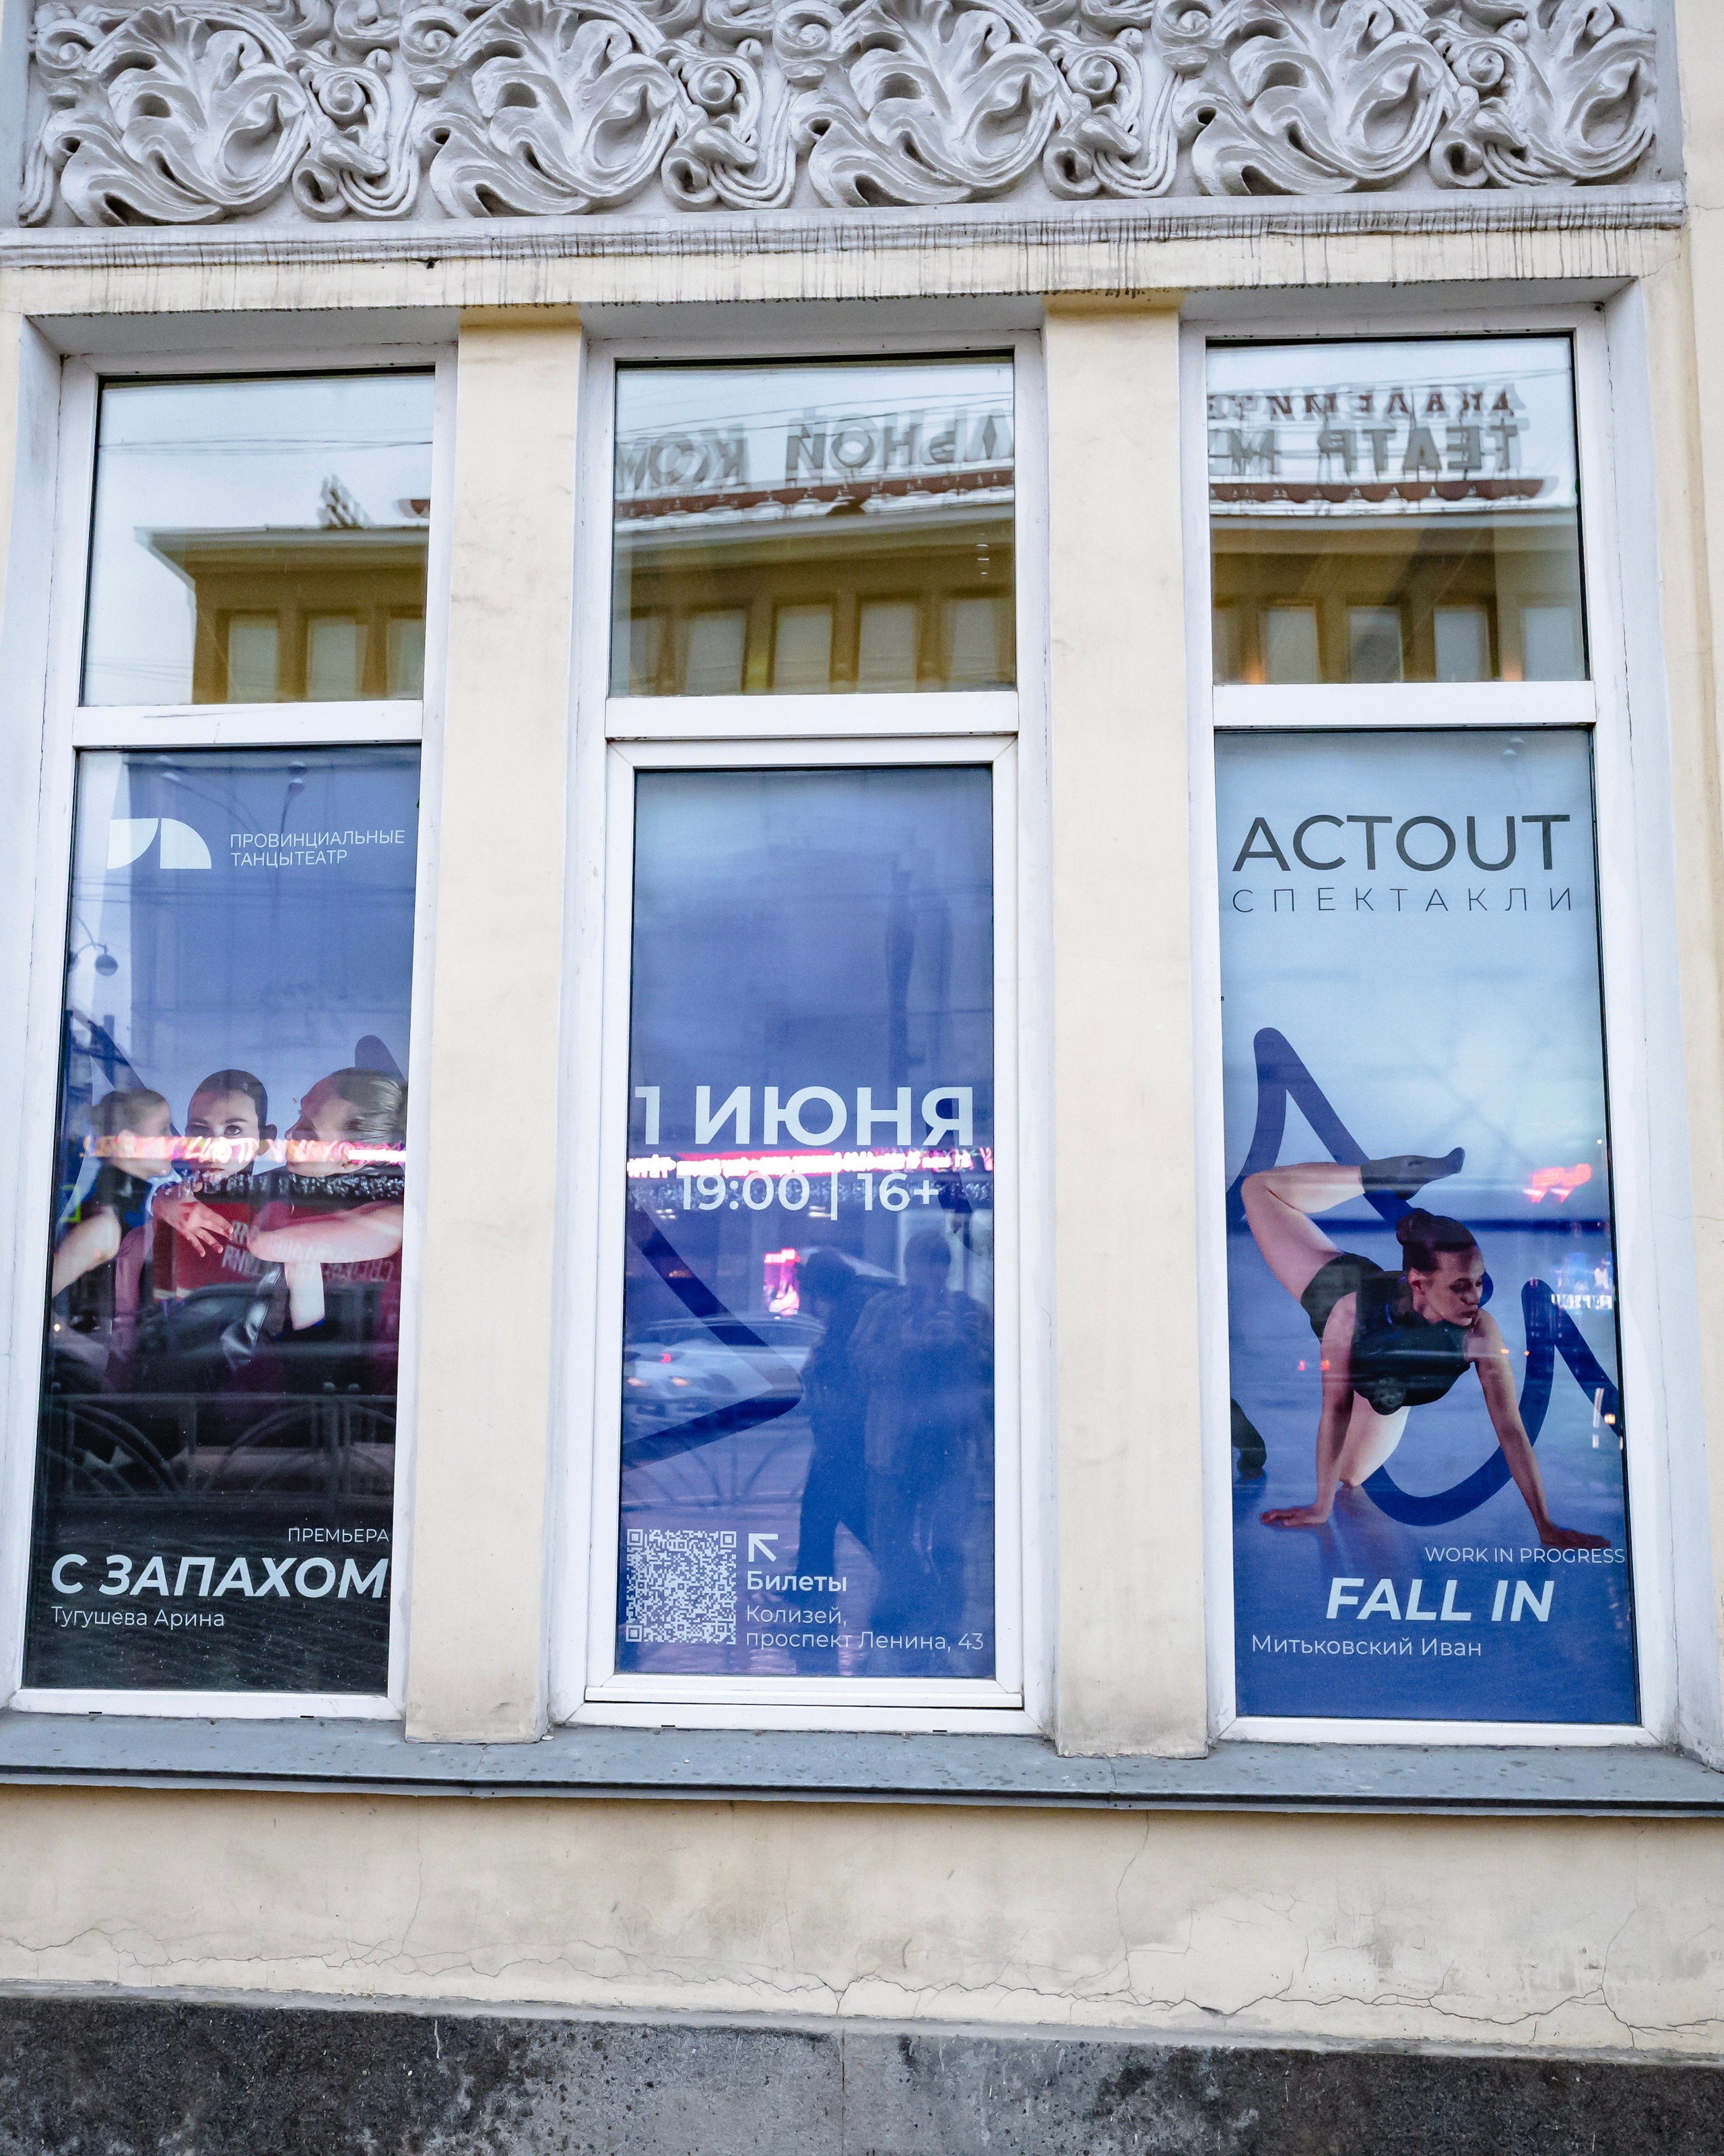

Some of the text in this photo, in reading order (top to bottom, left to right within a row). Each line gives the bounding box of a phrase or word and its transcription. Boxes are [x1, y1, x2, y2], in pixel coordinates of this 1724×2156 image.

[230, 830, 405, 848] ПРОВИНЦИАЛЬНЫЕ
[1232, 814, 1571, 872] ACTOUT
[1232, 887, 1572, 913] СПЕКТАКЛИ
[634, 1085, 974, 1147] 1 ИЮНЯ
[677, 1173, 810, 1211] 19:00
[857, 1173, 939, 1212] 16+
[288, 1528, 389, 1543] ПРЕМЬЕРА
[1425, 1547, 1626, 1564] WORK IN PROGRESS
[51, 1553, 389, 1599] С ЗАПАХОМ
[747, 1570, 848, 1592] Билеты
[1326, 1577, 1556, 1623] FALL IN
[51, 1606, 224, 1631] Тугушева Арина
[747, 1604, 847, 1627] Колизей,
[746, 1631, 984, 1652] проспект Ленина, 43
[1253, 1635, 1482, 1657] Митьковский Иван
